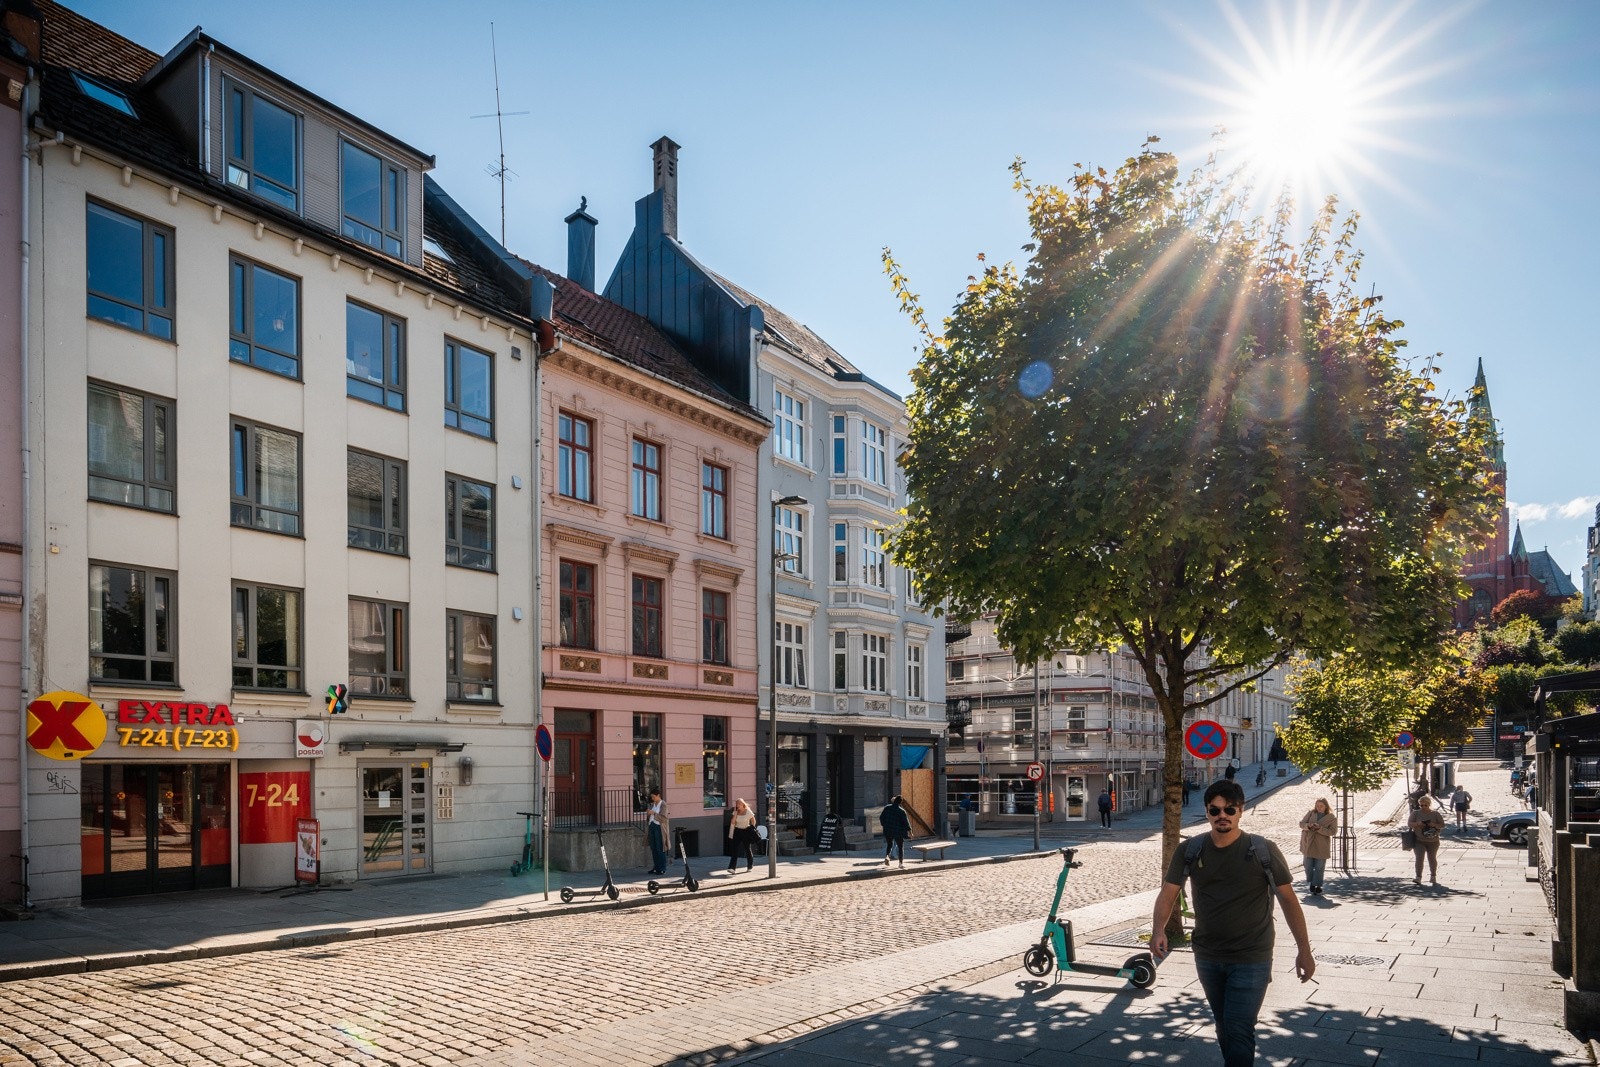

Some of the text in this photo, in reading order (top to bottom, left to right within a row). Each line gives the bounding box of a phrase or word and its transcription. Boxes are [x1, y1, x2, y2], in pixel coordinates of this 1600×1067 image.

[118, 699, 235, 726] EXTRA
[27, 700, 96, 752] X
[117, 726, 239, 752] 7-24 (7-23)
[441, 771, 450, 779] 12
[246, 783, 300, 807] 7-24
